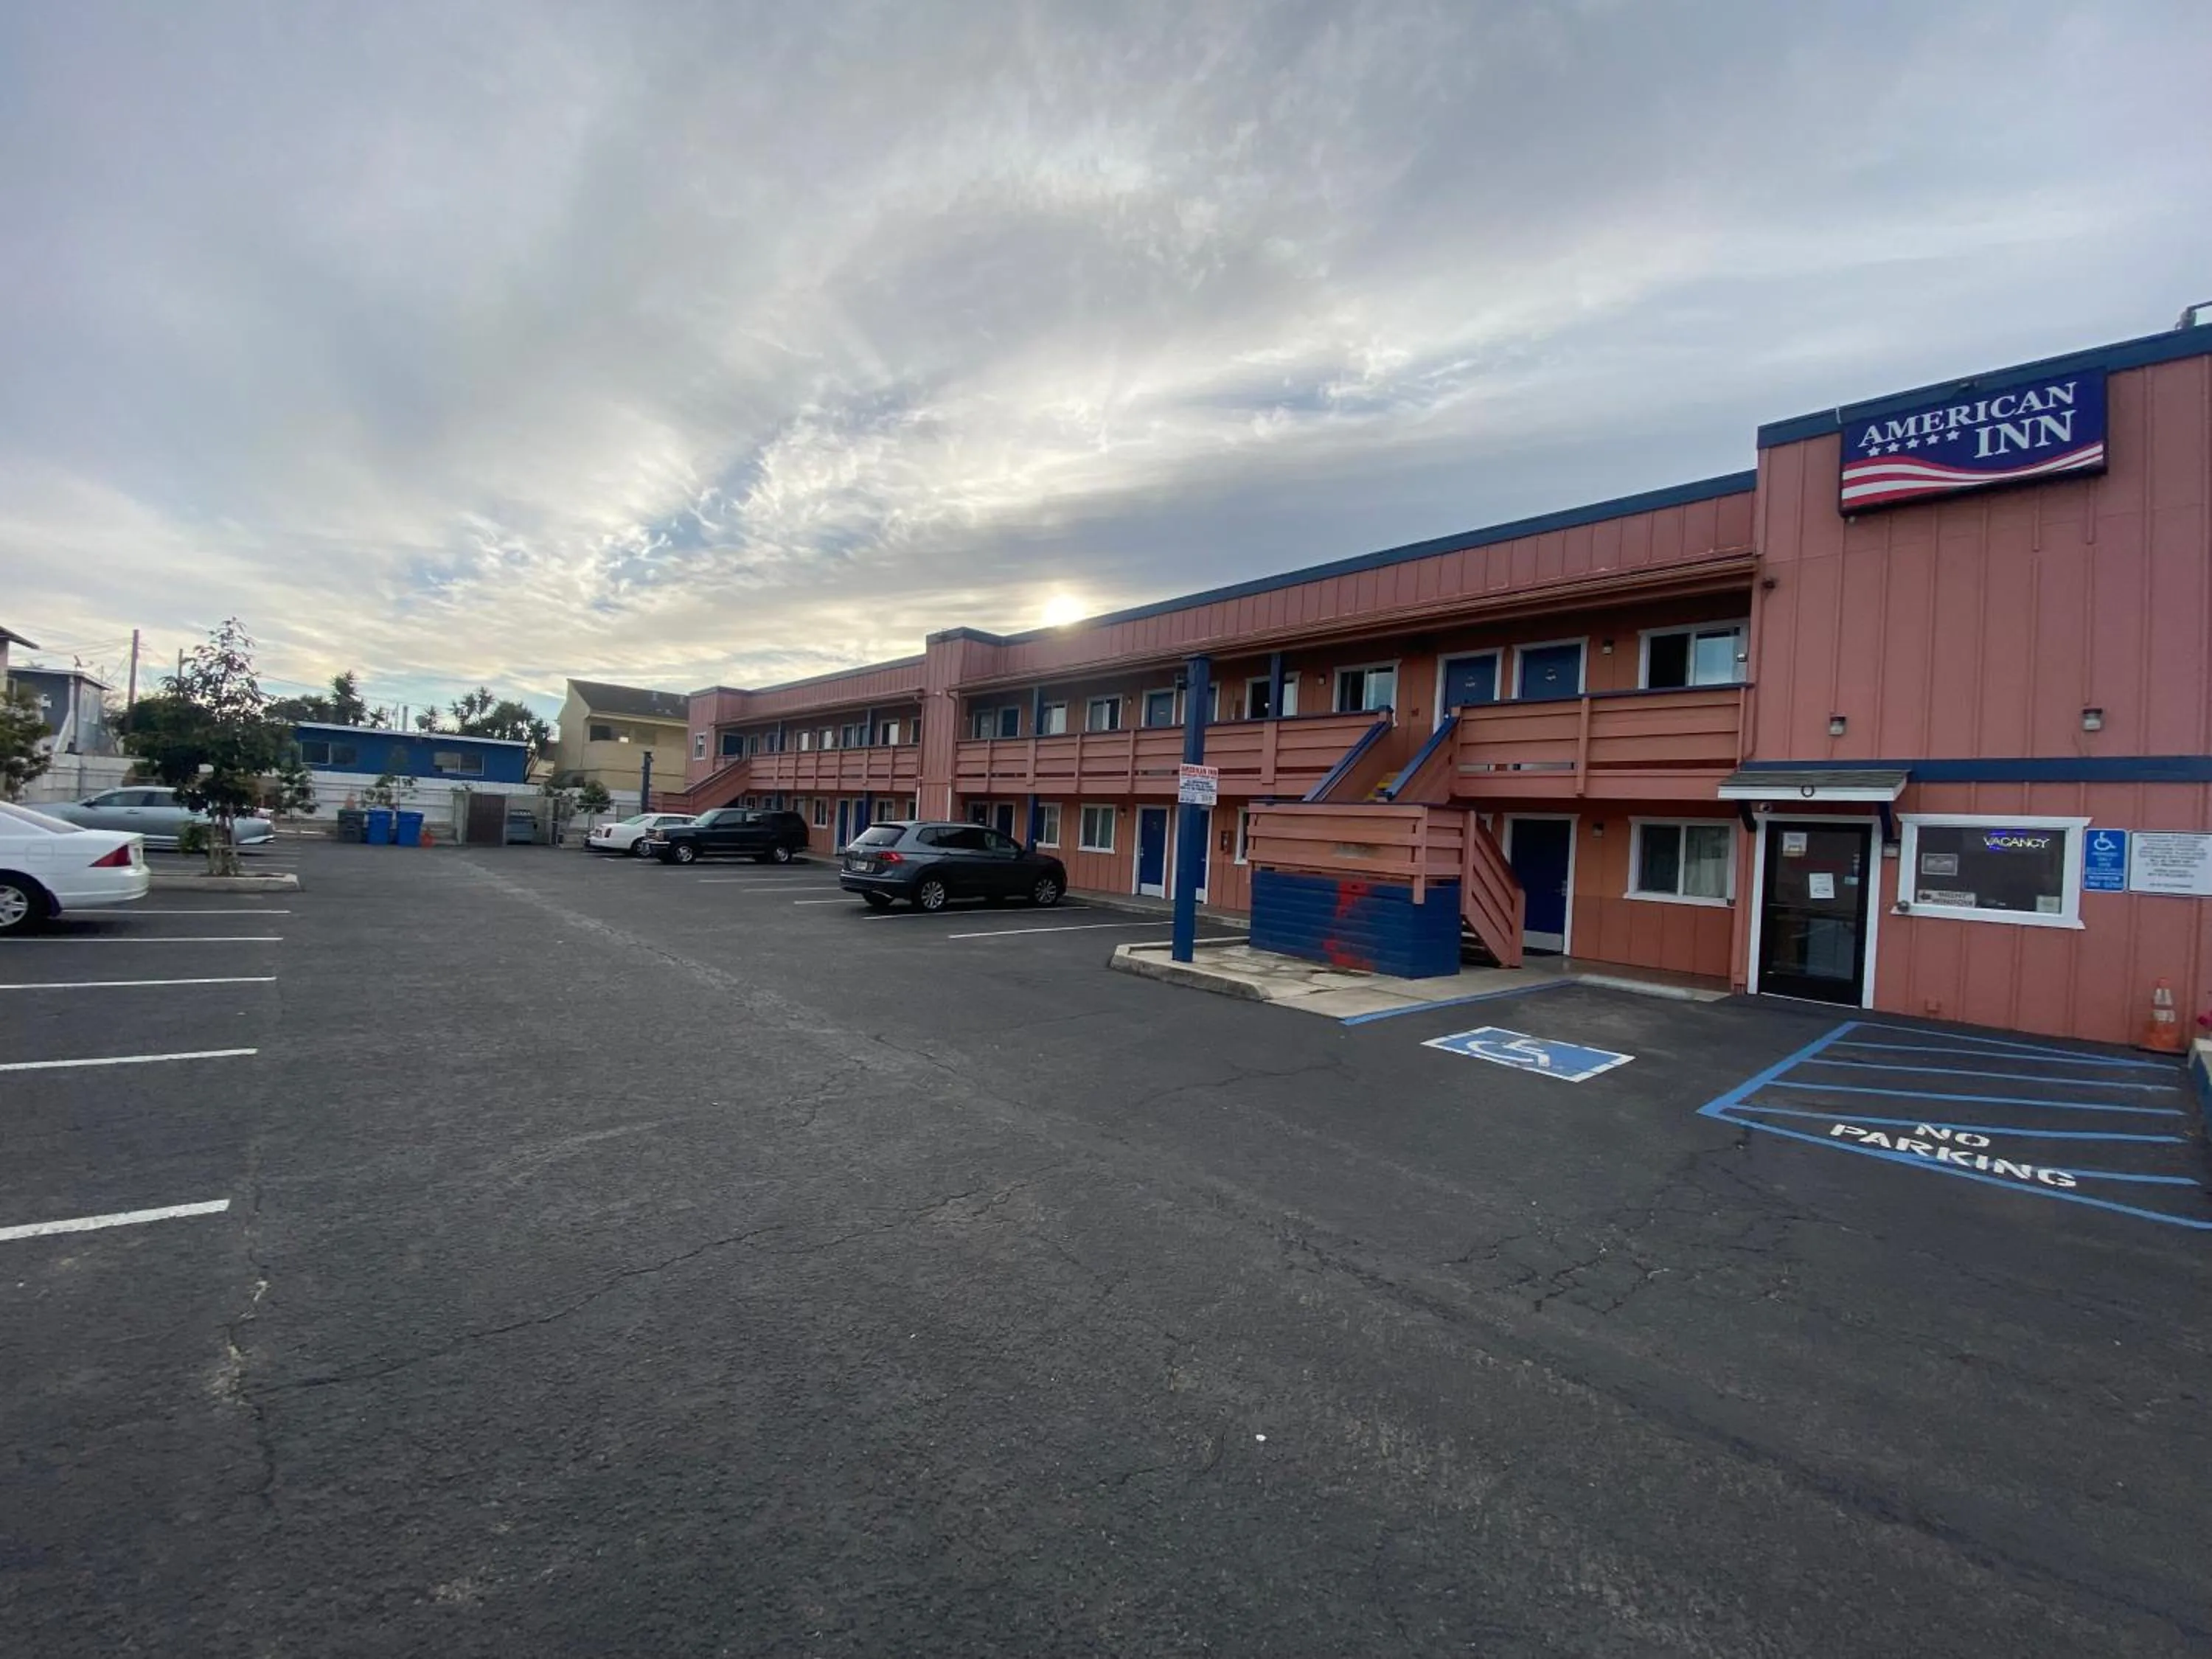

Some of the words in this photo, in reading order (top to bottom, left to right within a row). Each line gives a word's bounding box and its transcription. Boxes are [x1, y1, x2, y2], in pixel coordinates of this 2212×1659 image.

[1857, 381, 2078, 448] AMERICAN
[1973, 409, 2077, 459] INN
[1983, 835, 2051, 849] VACANCY
[1829, 1124, 2077, 1187] PARKING
[1915, 1122, 1991, 1148] NO
